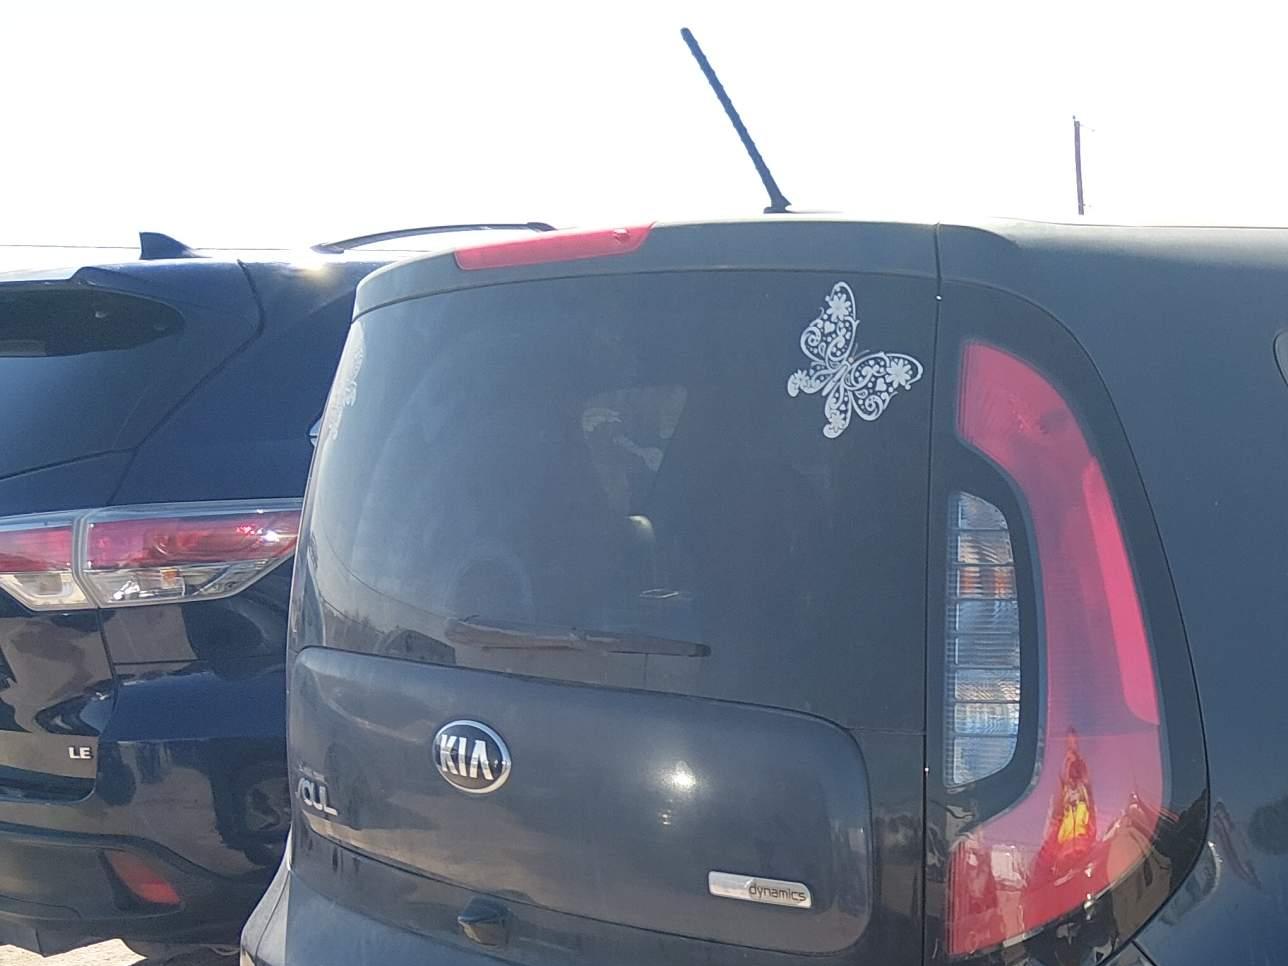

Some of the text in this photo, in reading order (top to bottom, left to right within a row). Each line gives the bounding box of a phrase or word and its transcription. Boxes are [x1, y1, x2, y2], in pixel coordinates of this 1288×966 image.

[68, 746, 92, 759] LE
[440, 734, 494, 781] KIA
[748, 883, 808, 902] dynamics
